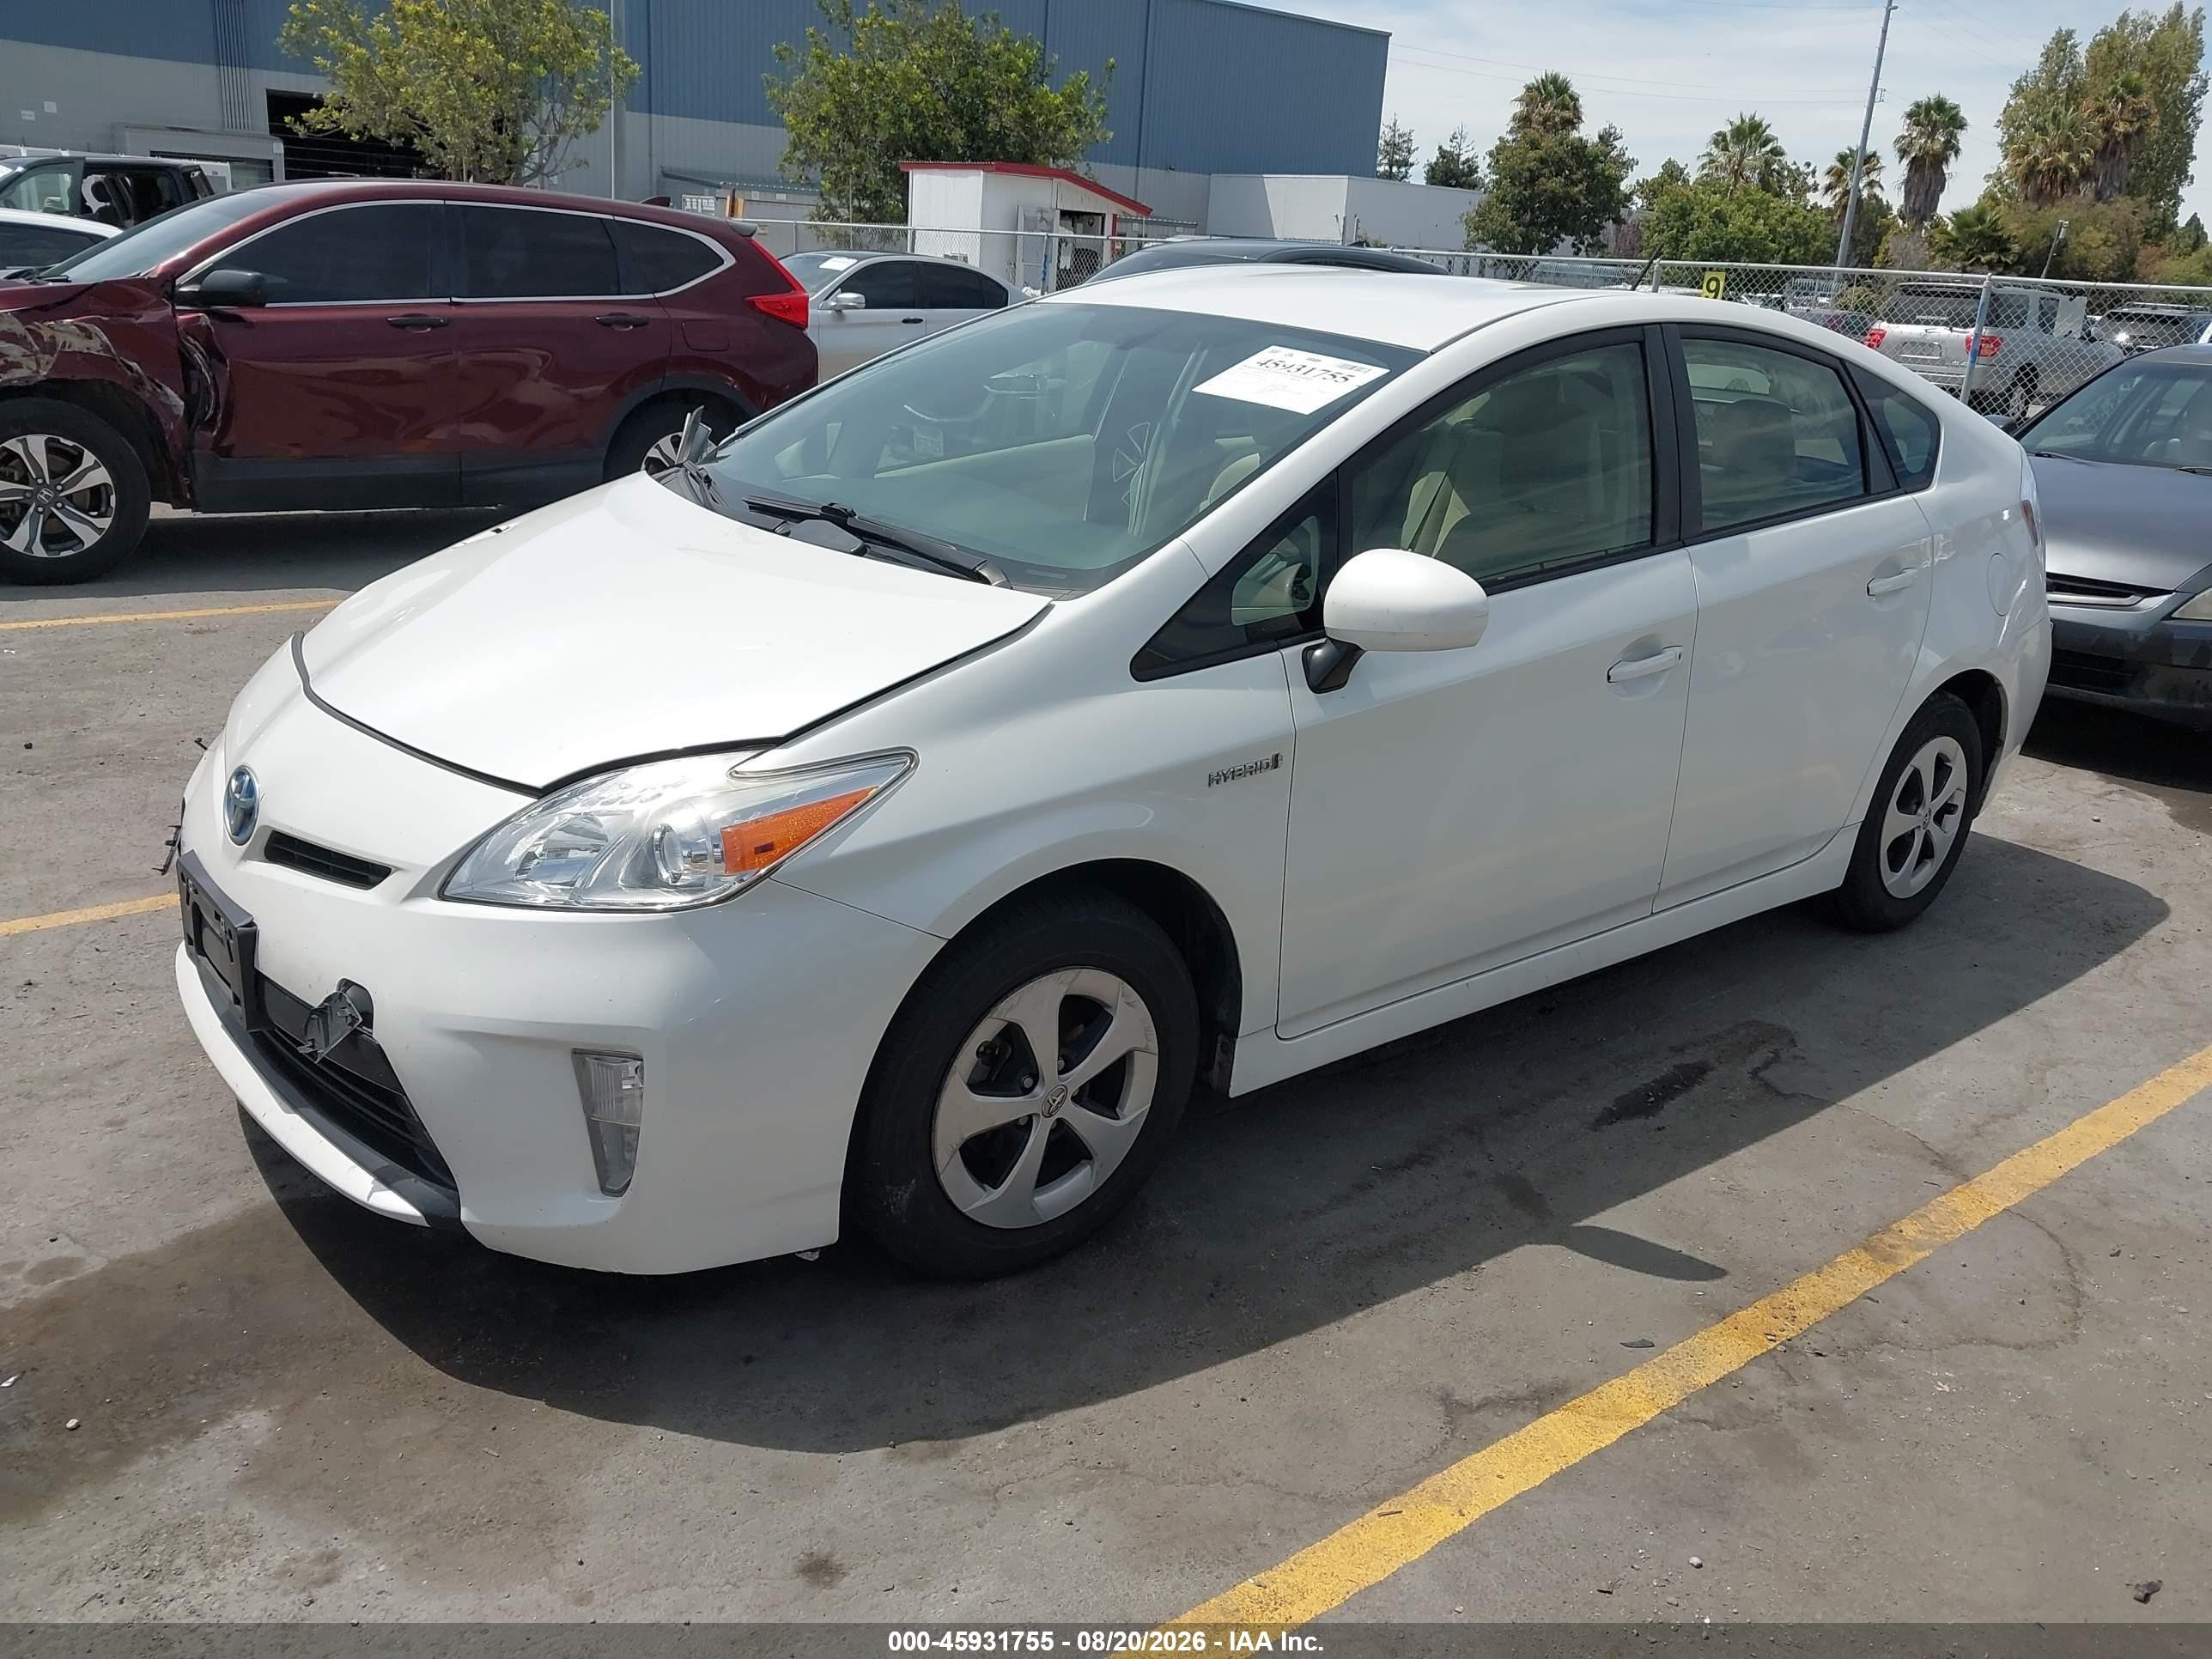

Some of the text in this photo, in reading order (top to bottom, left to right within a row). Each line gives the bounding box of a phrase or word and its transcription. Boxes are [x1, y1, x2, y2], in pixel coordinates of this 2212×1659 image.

[1706, 276, 1721, 300] 9
[1256, 354, 1356, 384] 45931755
[1207, 757, 1272, 787] HYBRID
